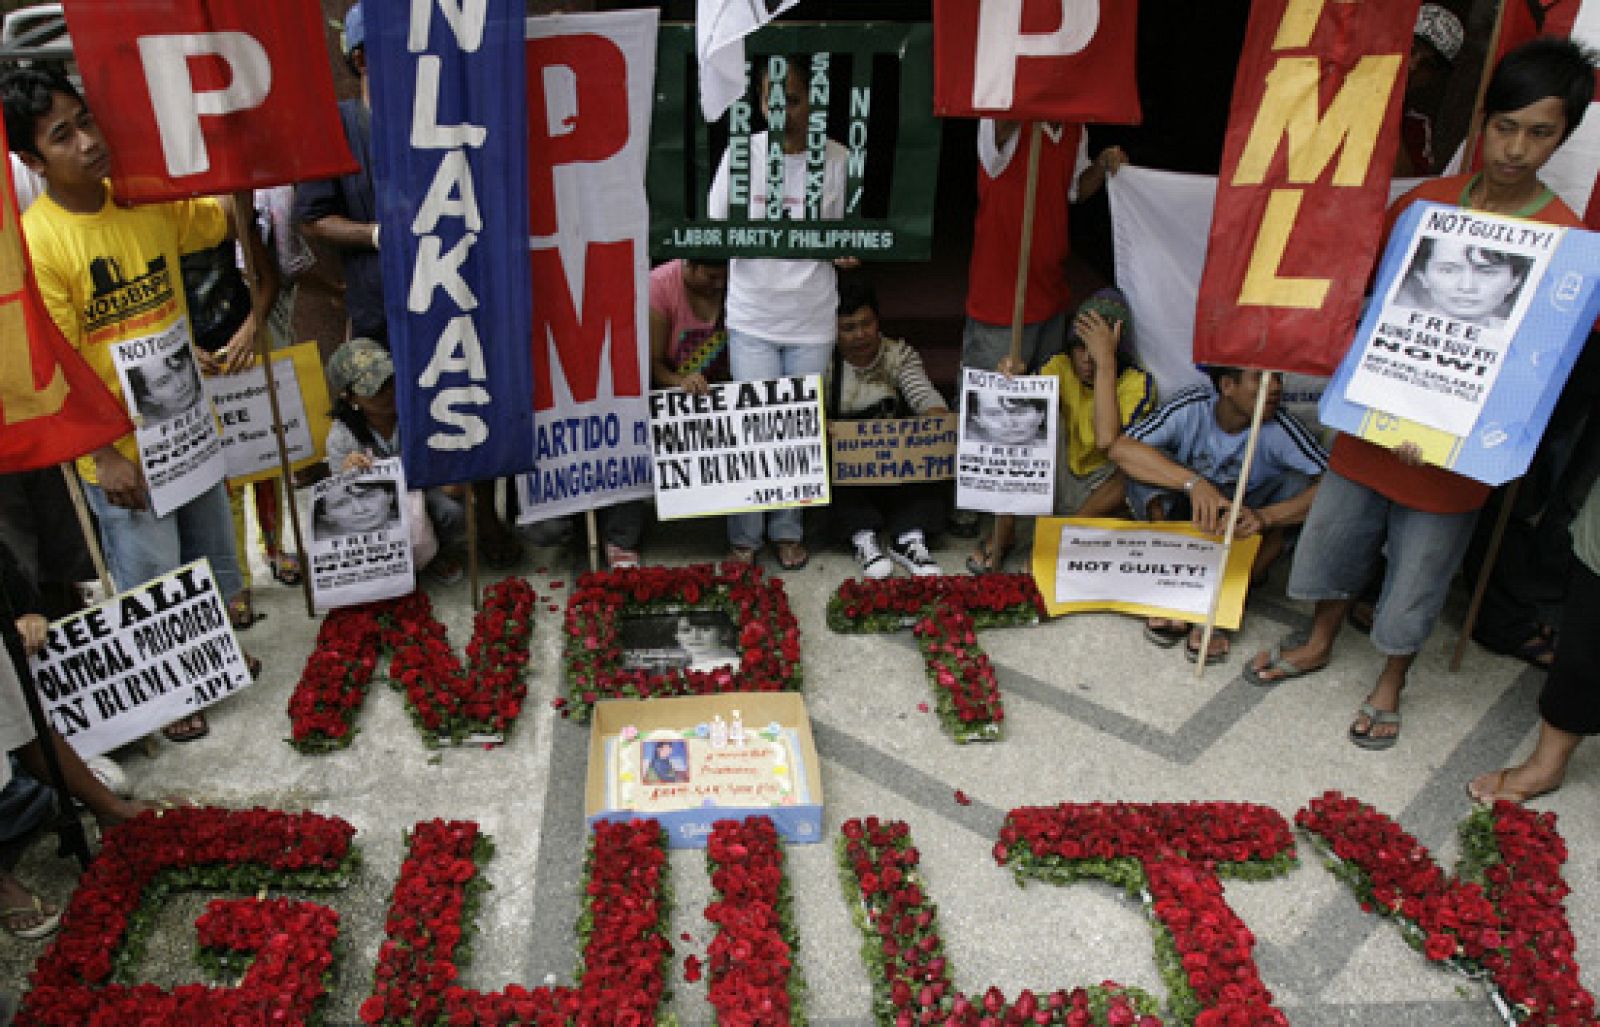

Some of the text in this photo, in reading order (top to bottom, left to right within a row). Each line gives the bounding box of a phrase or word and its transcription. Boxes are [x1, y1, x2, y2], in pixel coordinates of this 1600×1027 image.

[973, 0, 1100, 110] P
[137, 31, 271, 177] P
[728, 229, 783, 246] PARTY
[788, 229, 894, 248] PHILIPPINES
[1408, 312, 1482, 342] FREE
[650, 377, 817, 419] FREE ALL
[534, 411, 620, 461] ARTIDO
[657, 458, 692, 490] IN
[699, 450, 771, 485] BURMA
[1067, 560, 1208, 578] NOT GUILTY!
[118, 569, 213, 630] ALL
[37, 636, 136, 703] OLITICAL
[93, 659, 182, 721] BURMA
